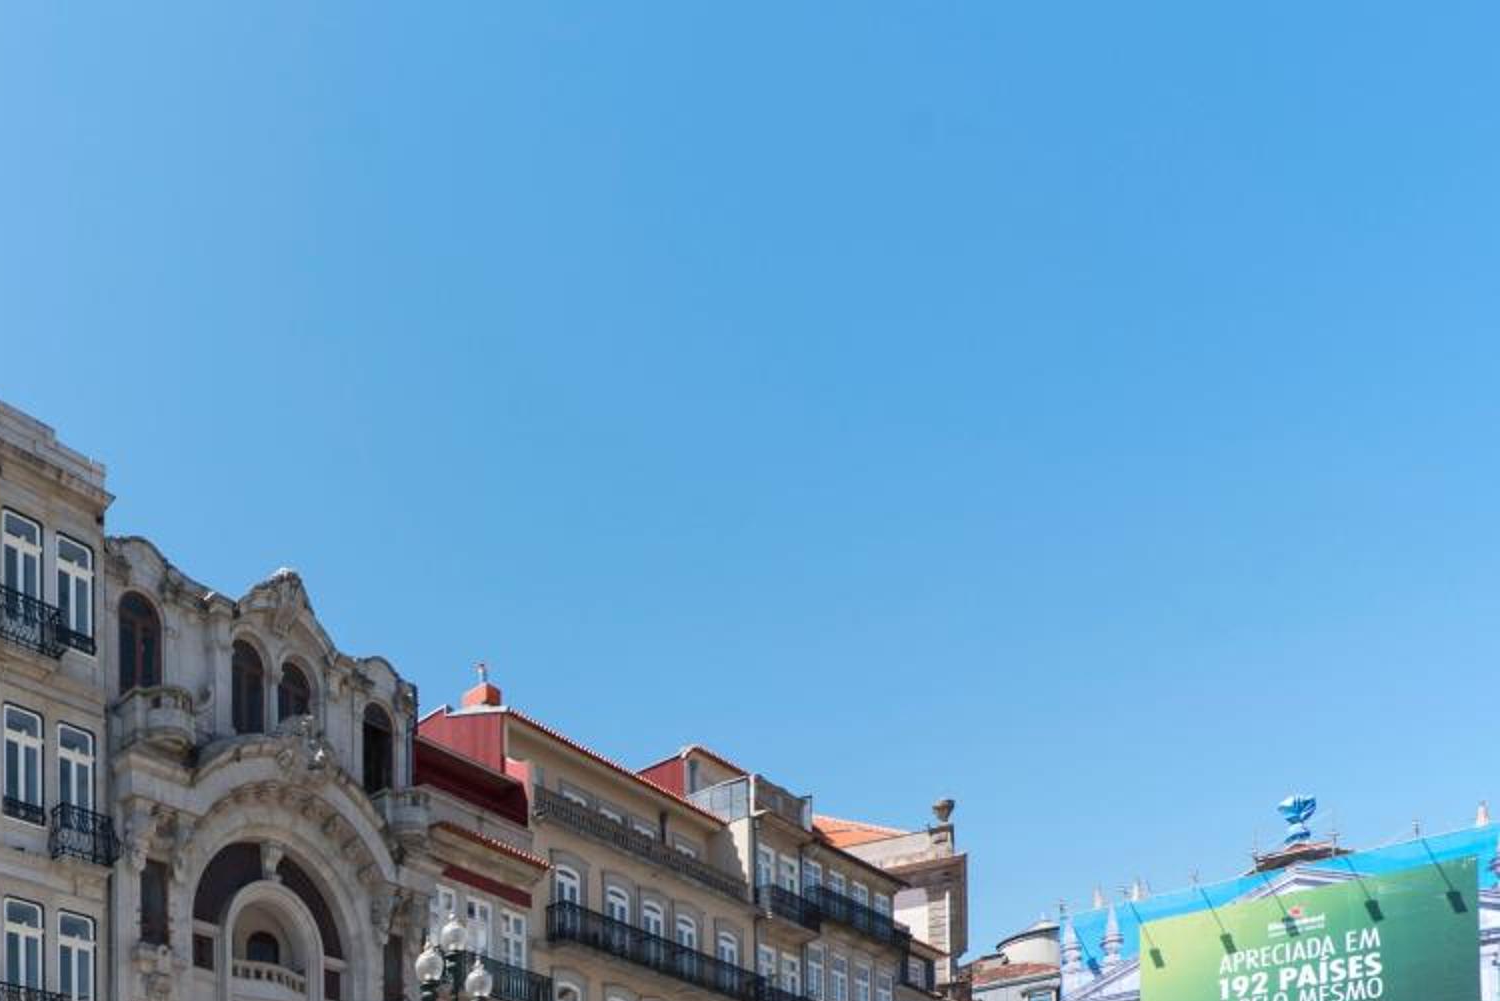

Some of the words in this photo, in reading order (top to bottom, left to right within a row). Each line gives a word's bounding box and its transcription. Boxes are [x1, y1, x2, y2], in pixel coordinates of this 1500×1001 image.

[1219, 935, 1336, 975] APRECIADA
[1346, 926, 1381, 953] EM
[1219, 971, 1269, 1001] 192
[1279, 951, 1383, 991] PAÍSES
